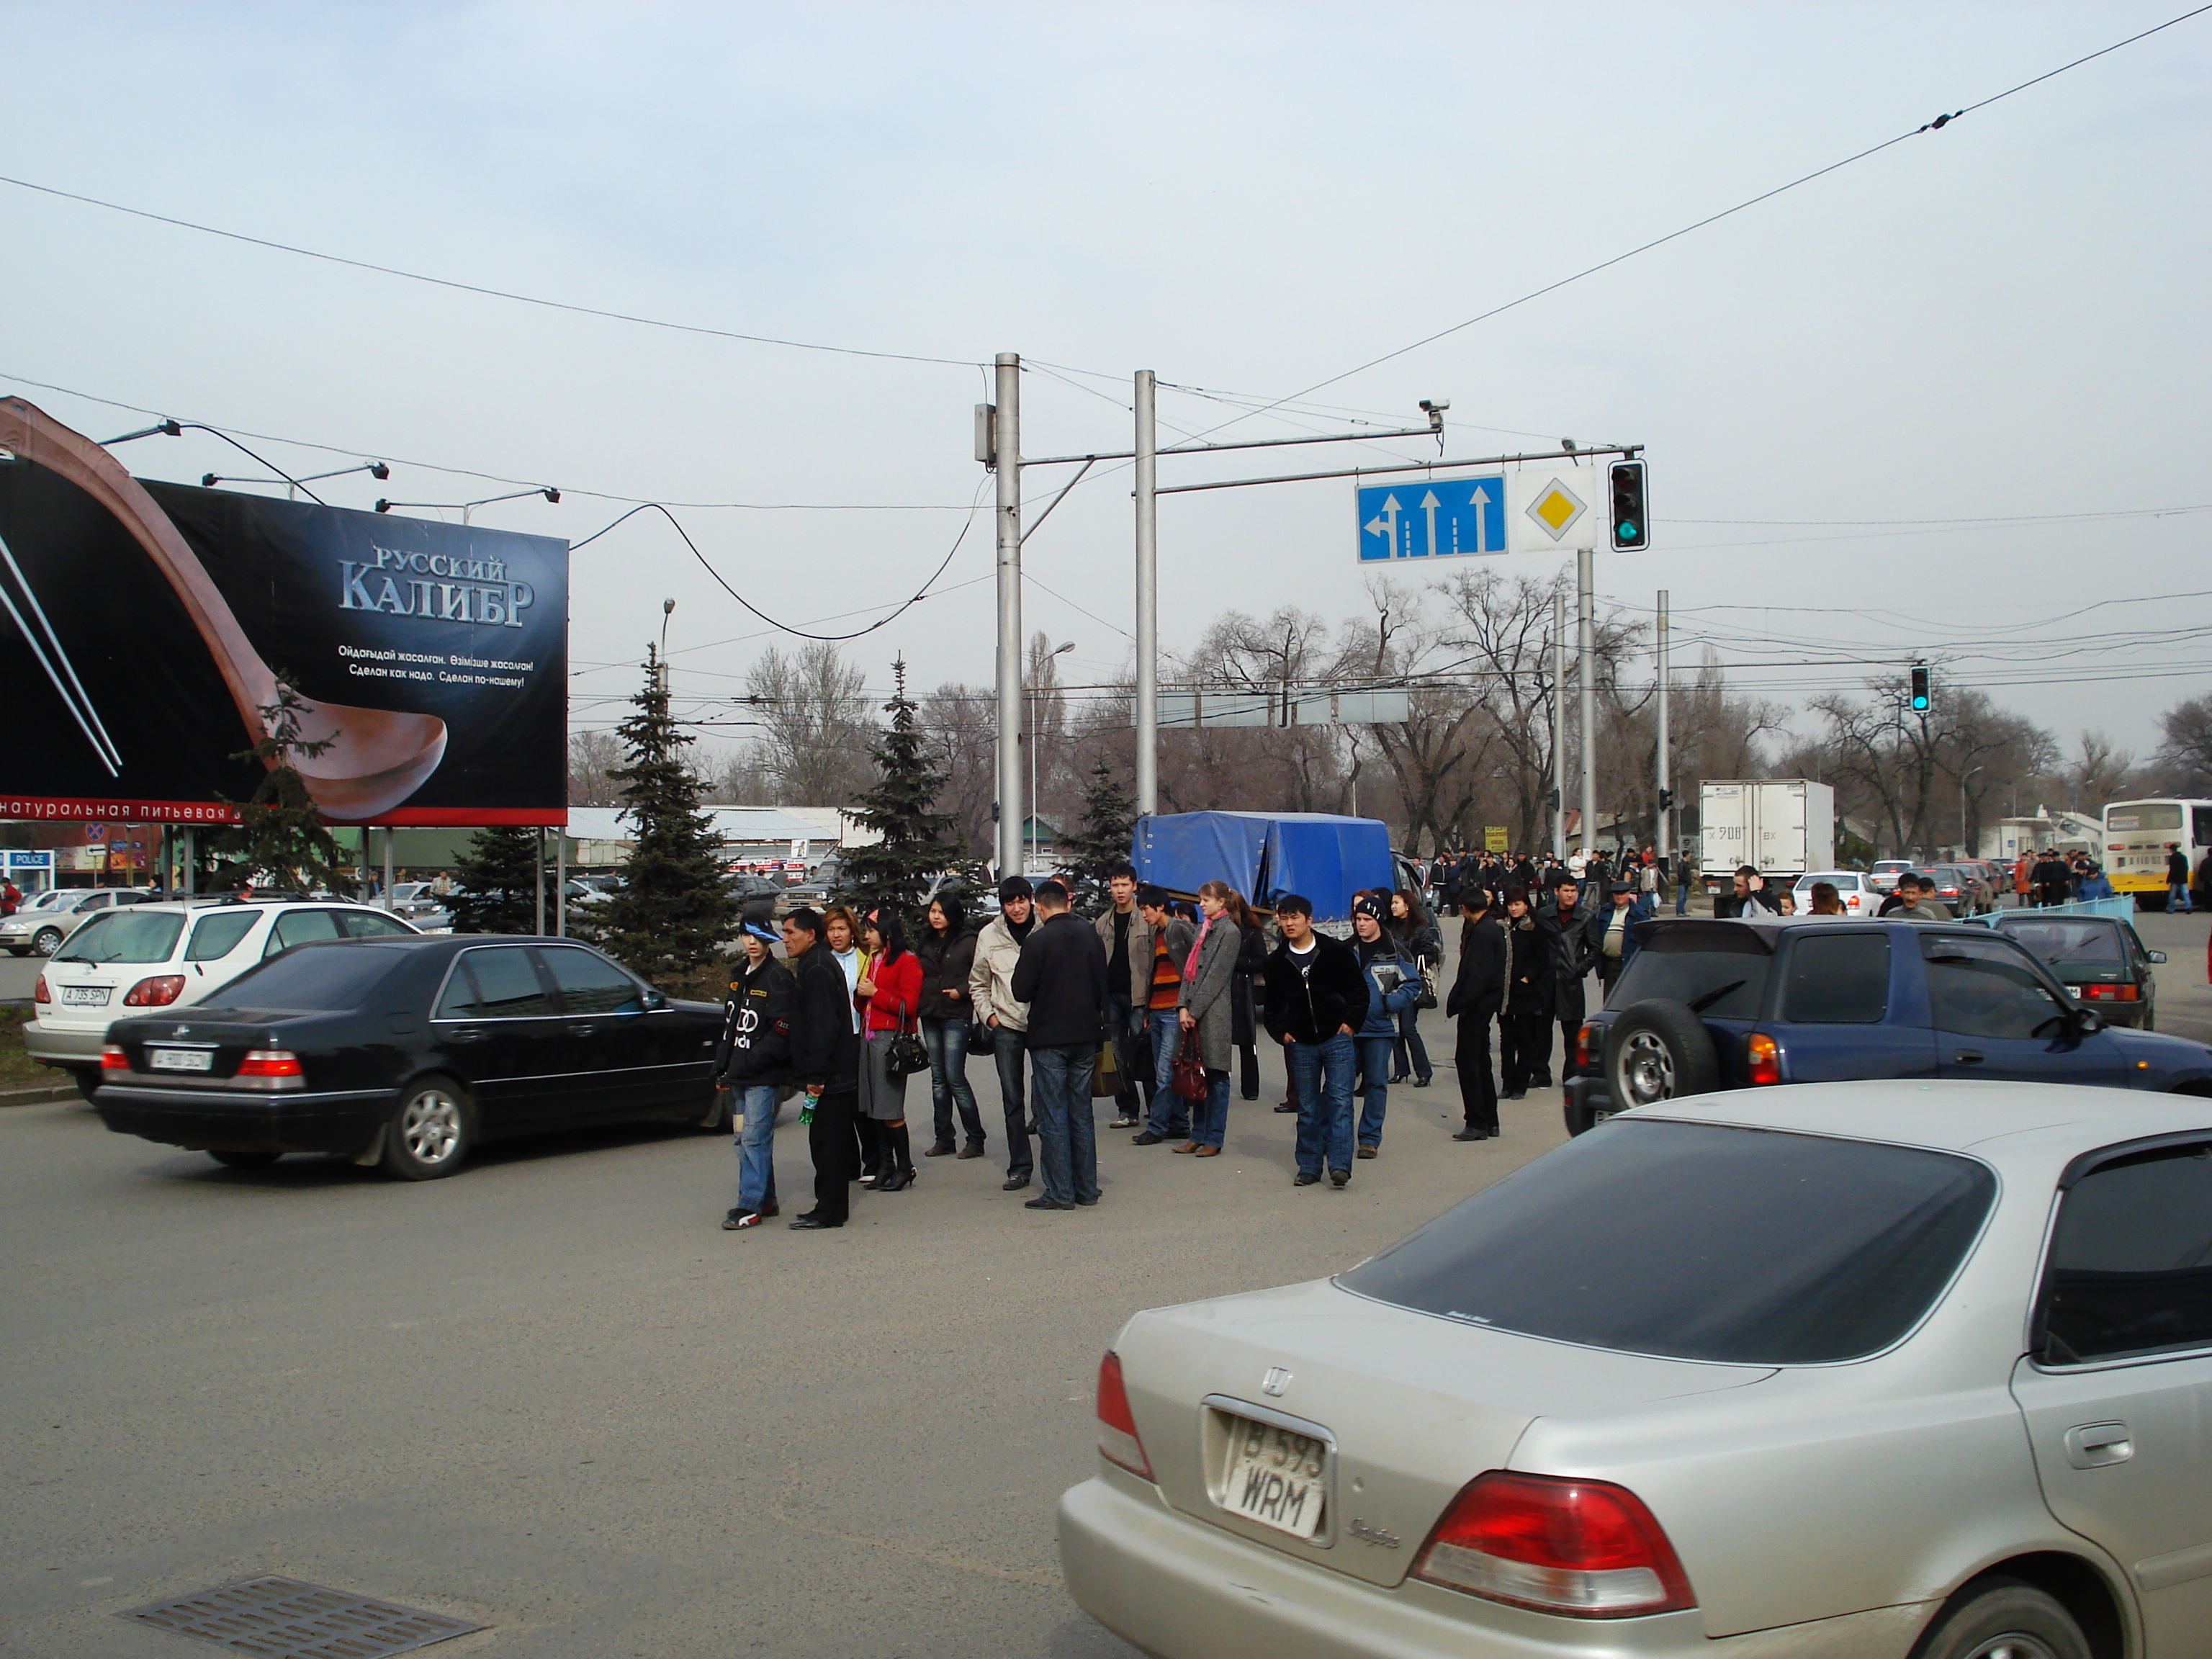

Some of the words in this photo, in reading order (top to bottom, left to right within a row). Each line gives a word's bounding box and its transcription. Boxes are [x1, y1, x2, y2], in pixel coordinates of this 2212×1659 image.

[373, 544, 507, 583] РУССКИЙ
[338, 559, 534, 627] КАЛИБР
[338, 645, 395, 660] Ойдағыдай
[397, 651, 446, 665] жасалған.
[450, 655, 489, 668] Өзімізше
[490, 660, 533, 671] жасалған!
[349, 664, 387, 678] Сделан
[390, 668, 406, 678] как
[409, 670, 434, 681] надо.
[439, 671, 472, 683] Сделан
[475, 675, 524, 688] по-нашему!
[0, 801, 130, 818] натуральная
[140, 805, 225, 819] питьевая
[1719, 827, 1741, 840] 908
[17, 855, 44, 864] POLICE
[66, 989, 71, 999] A
[74, 989, 89, 999] 735
[90, 989, 107, 1000] SPN
[1242, 1465, 1308, 1528] WRM
